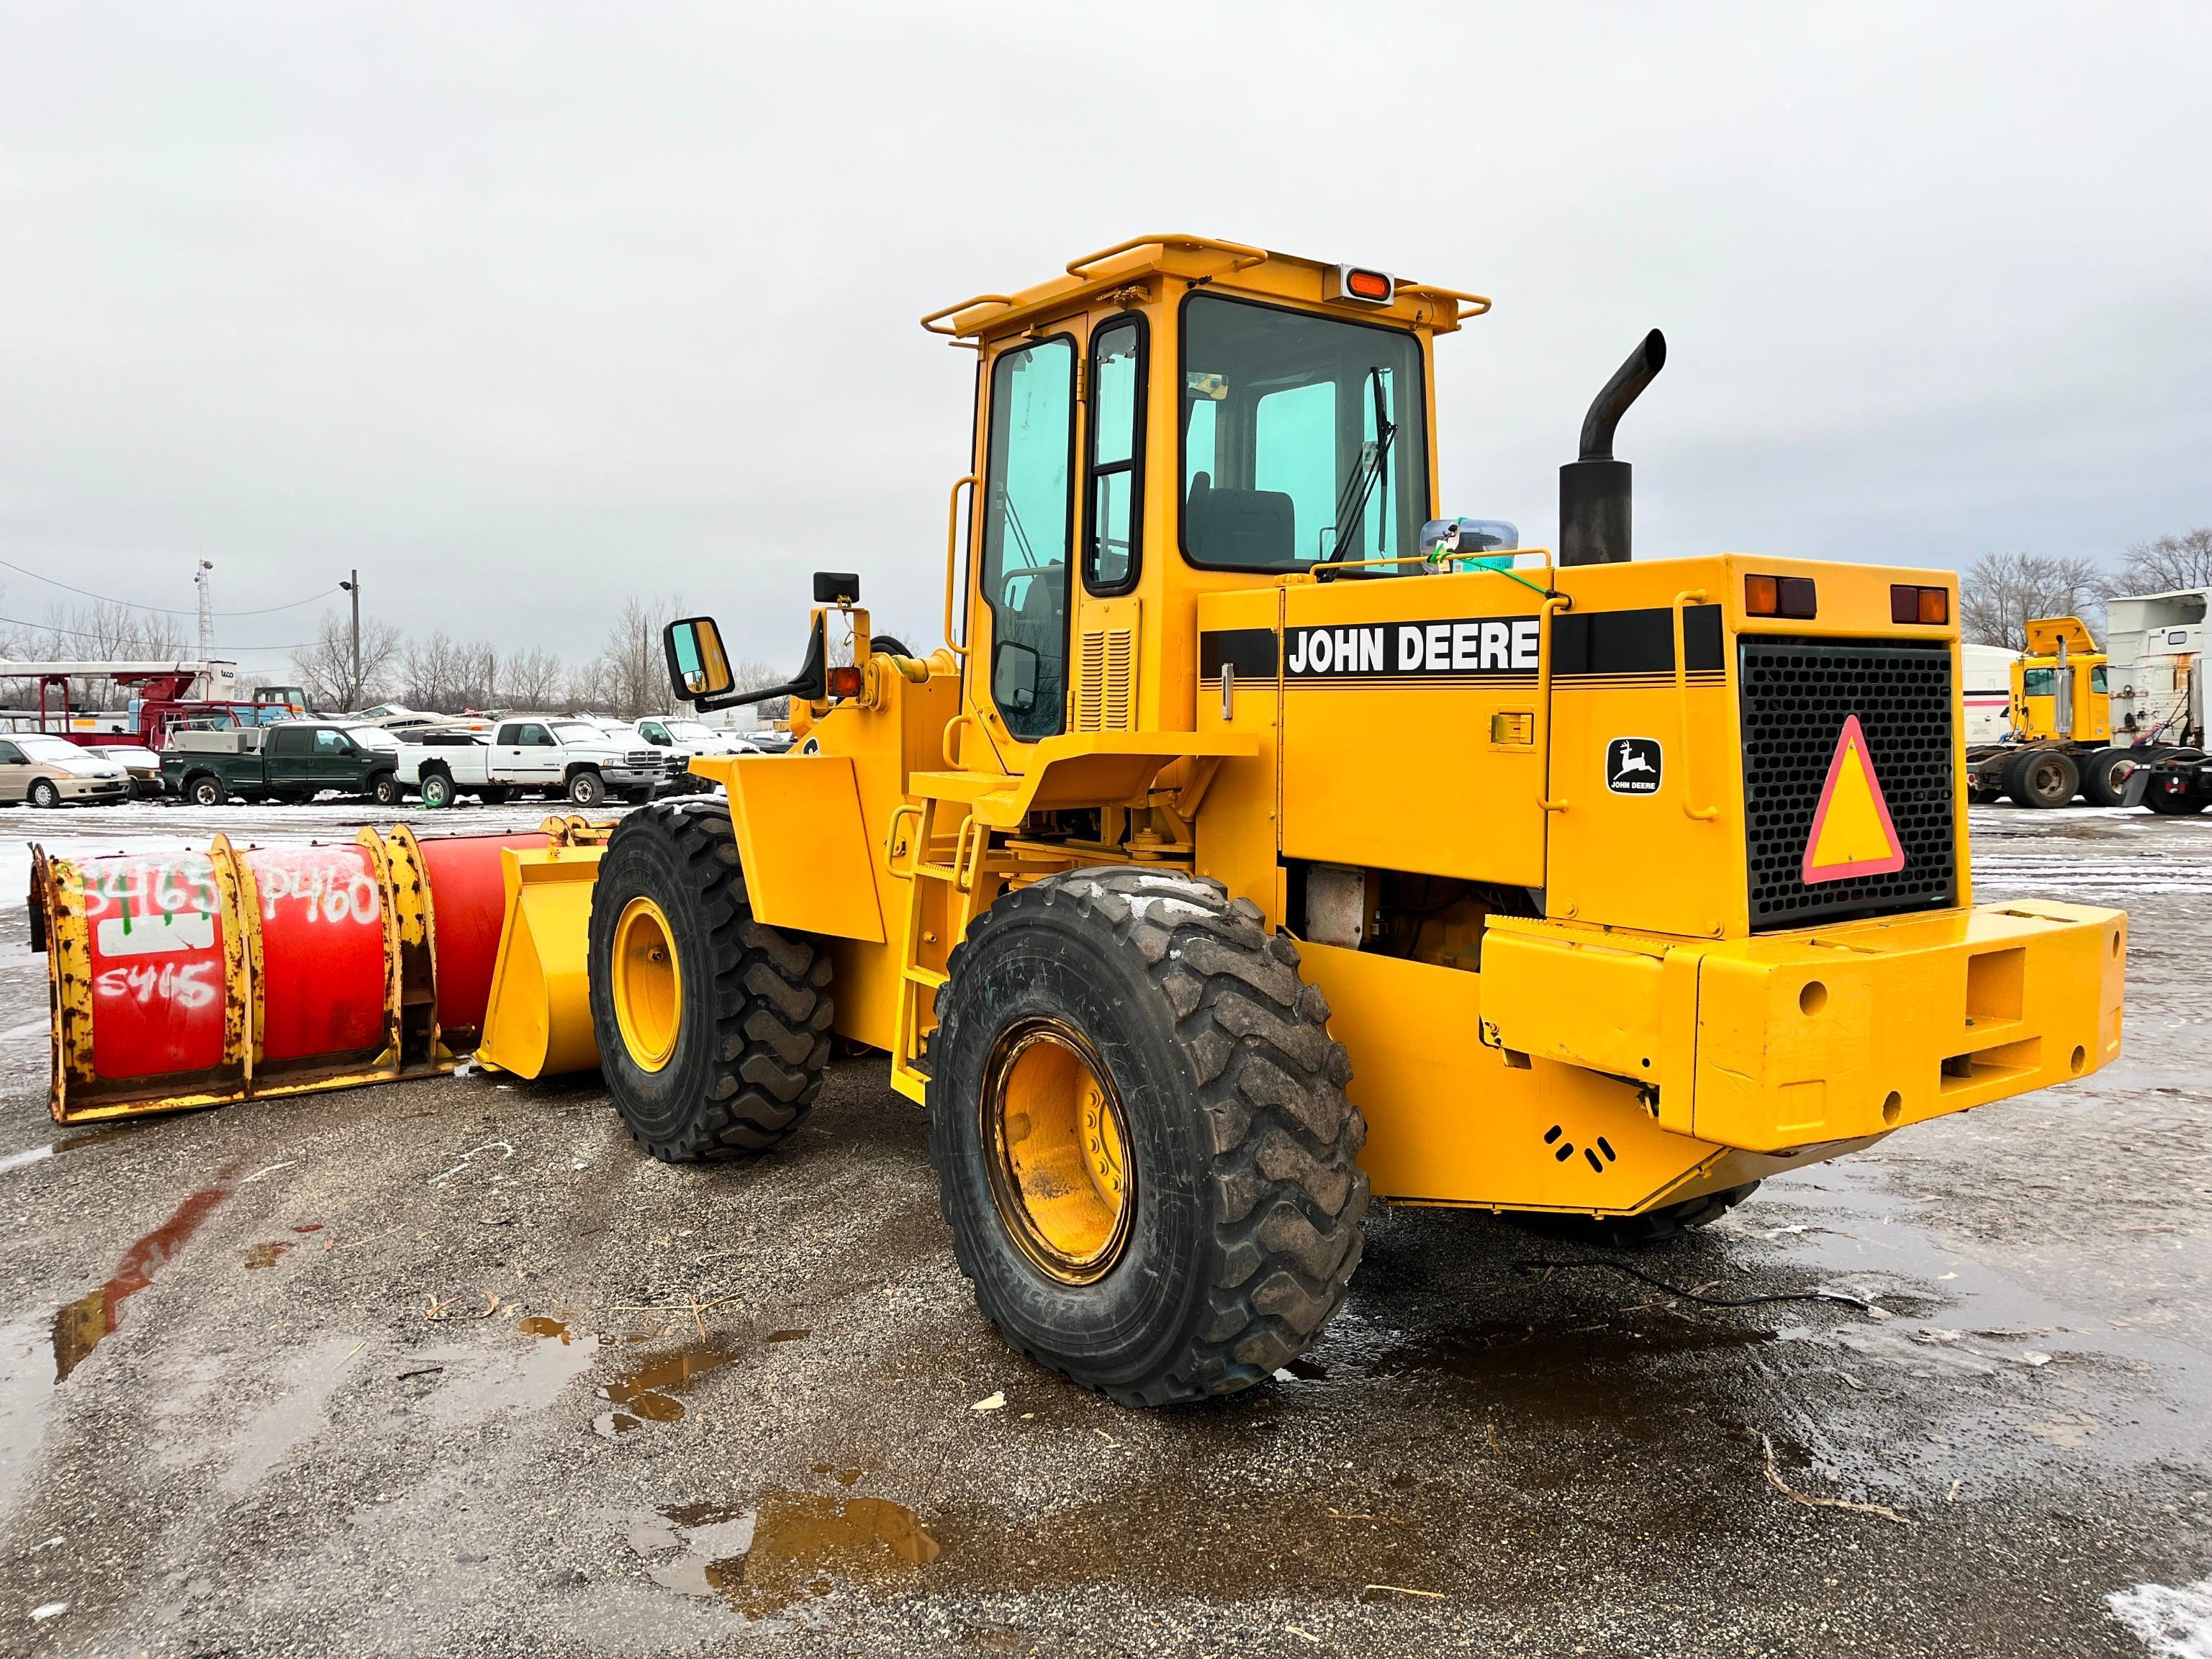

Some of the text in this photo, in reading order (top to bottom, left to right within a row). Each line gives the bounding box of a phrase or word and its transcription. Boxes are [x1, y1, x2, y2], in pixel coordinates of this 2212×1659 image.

[1288, 620, 1540, 674] JOHN DEERE
[262, 864, 381, 925] P460
